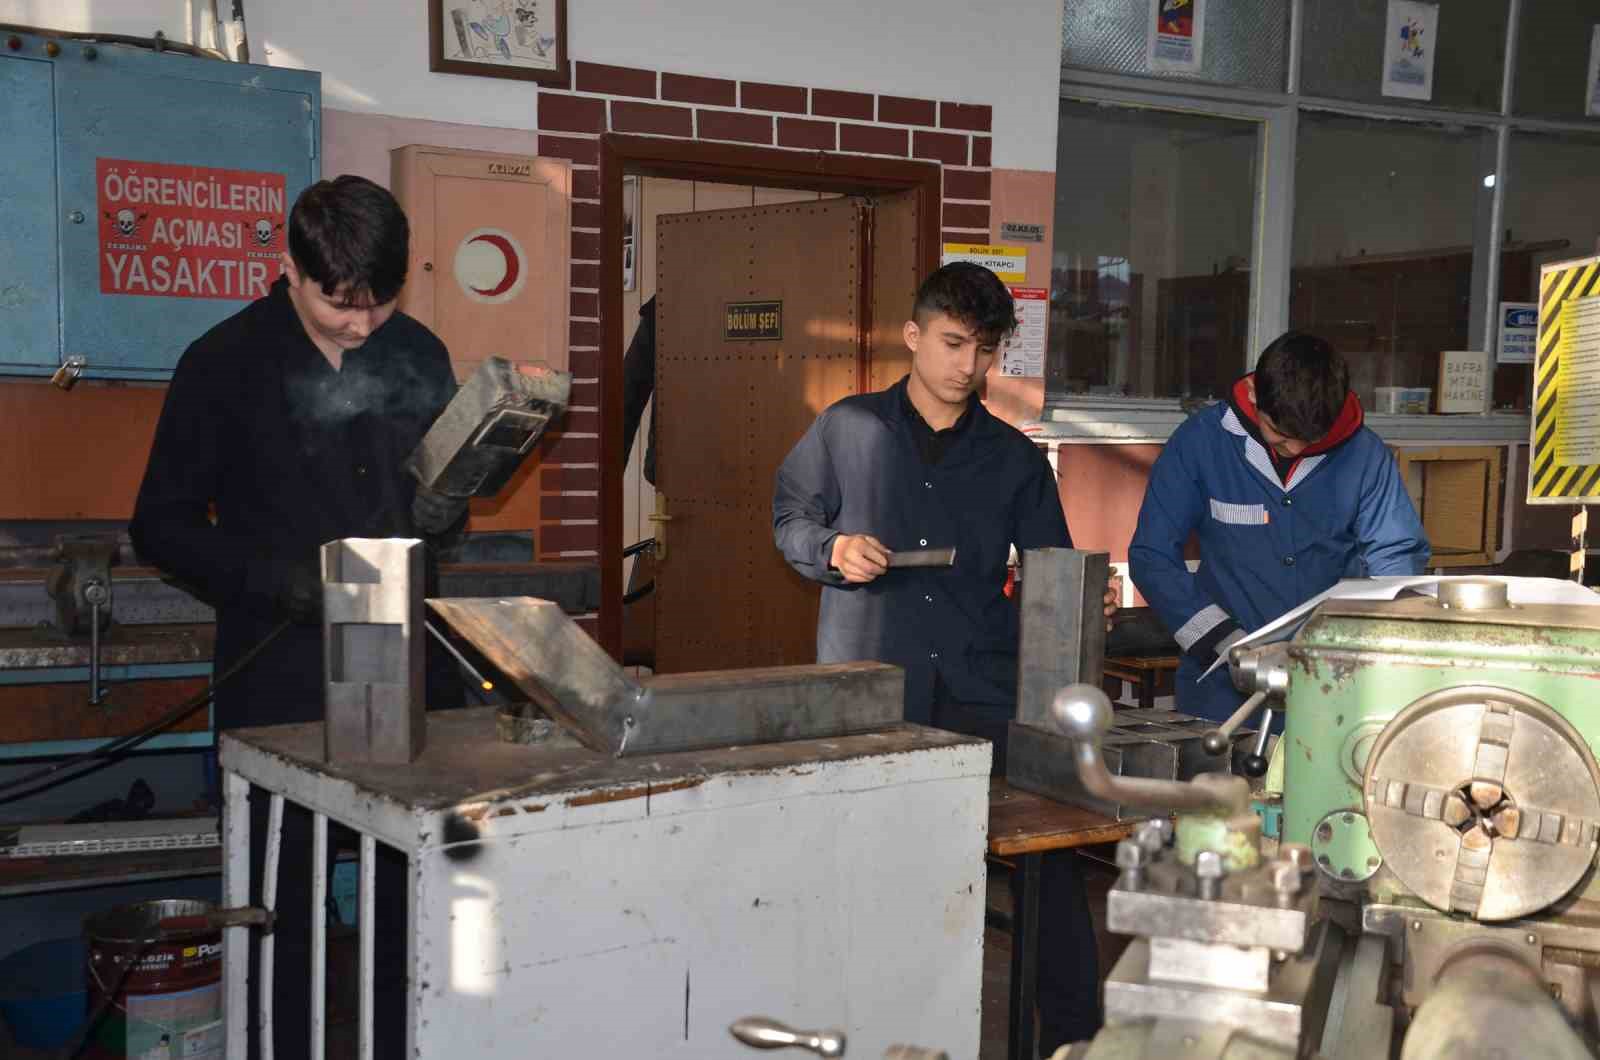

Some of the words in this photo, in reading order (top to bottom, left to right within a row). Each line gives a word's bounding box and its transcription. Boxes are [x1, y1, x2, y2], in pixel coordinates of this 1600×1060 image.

[104, 168, 283, 214] ÖĞRENCİLERİN
[151, 217, 242, 251] AÇMASI
[106, 253, 270, 297] YASAKTIR
[728, 308, 757, 330] BÖLÜM
[759, 307, 778, 334] ŞEFİ
